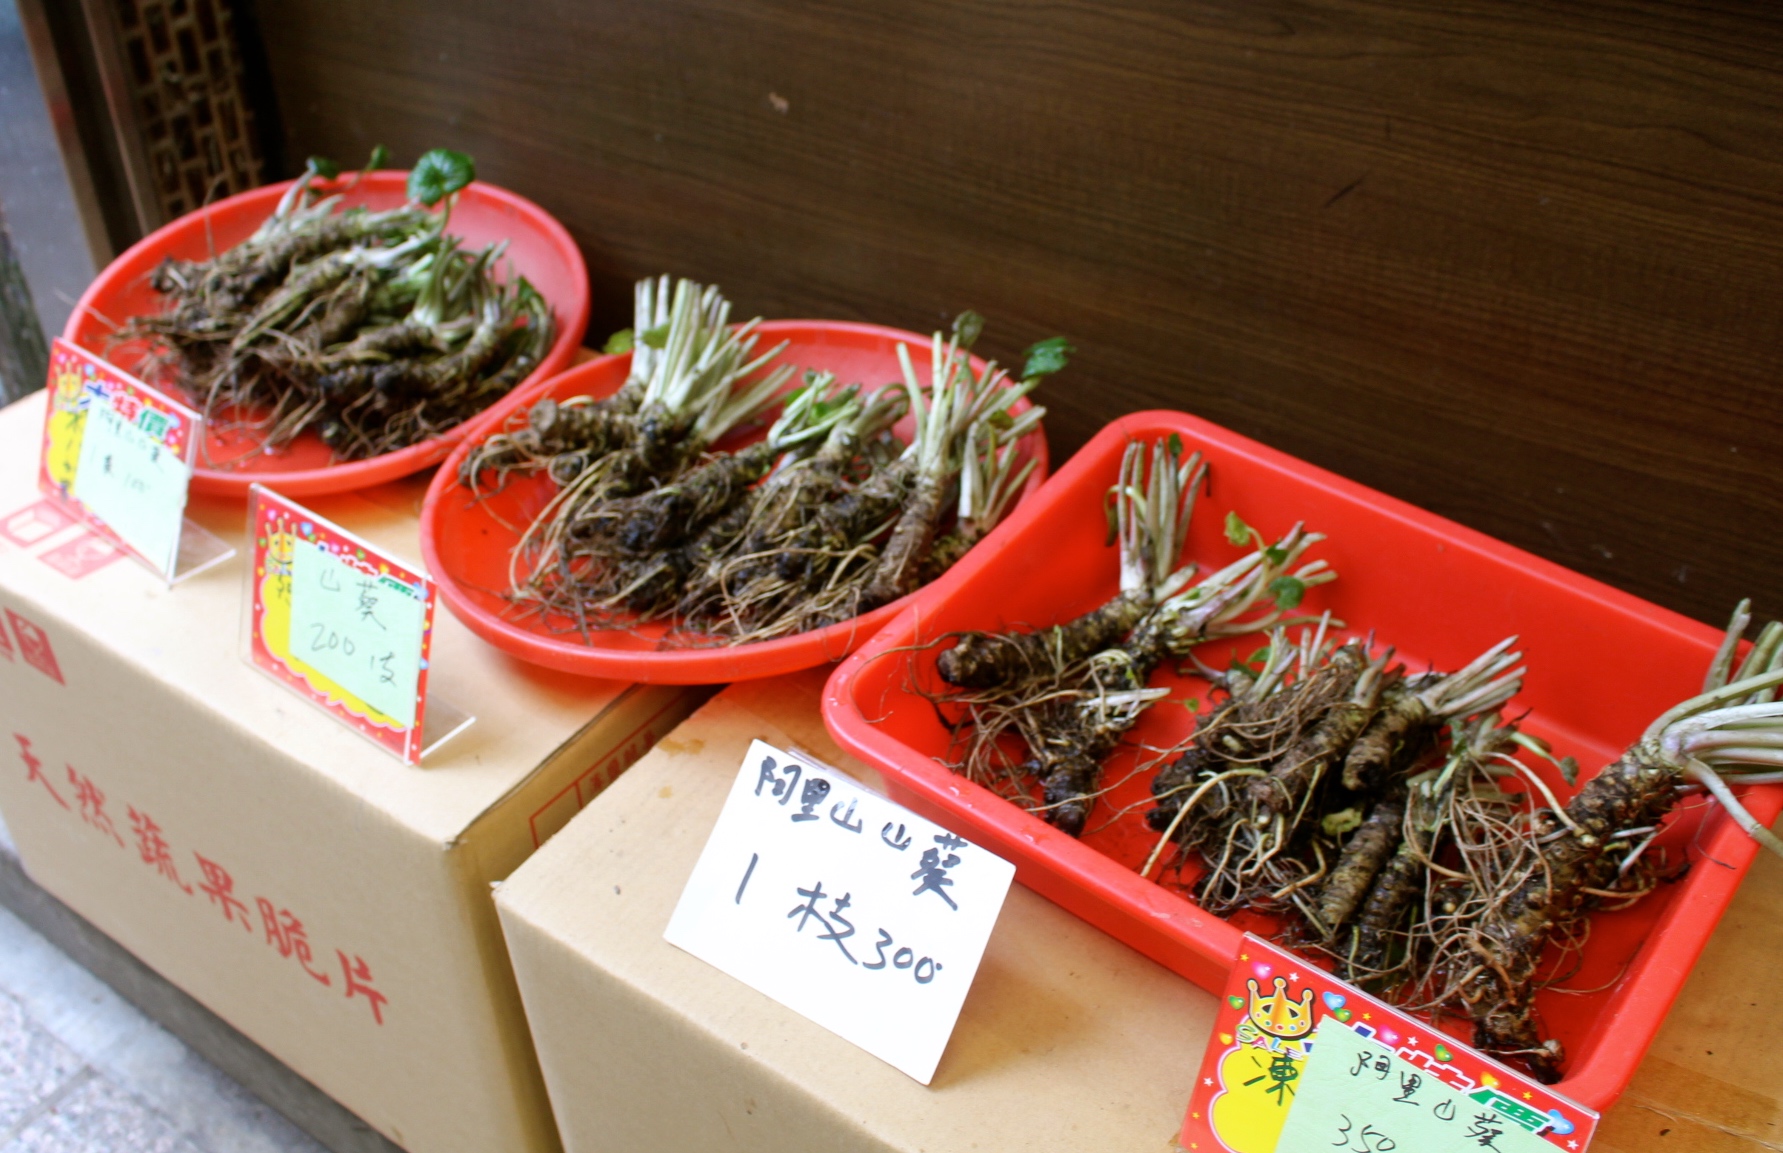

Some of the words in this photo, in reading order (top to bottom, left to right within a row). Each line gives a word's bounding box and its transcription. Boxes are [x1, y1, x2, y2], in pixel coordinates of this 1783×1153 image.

[311, 622, 356, 652] 200
[12, 732, 389, 1026] 天然蔬果脆片
[1236, 1023, 1304, 1060] SALE
[1331, 1113, 1396, 1153] 350
